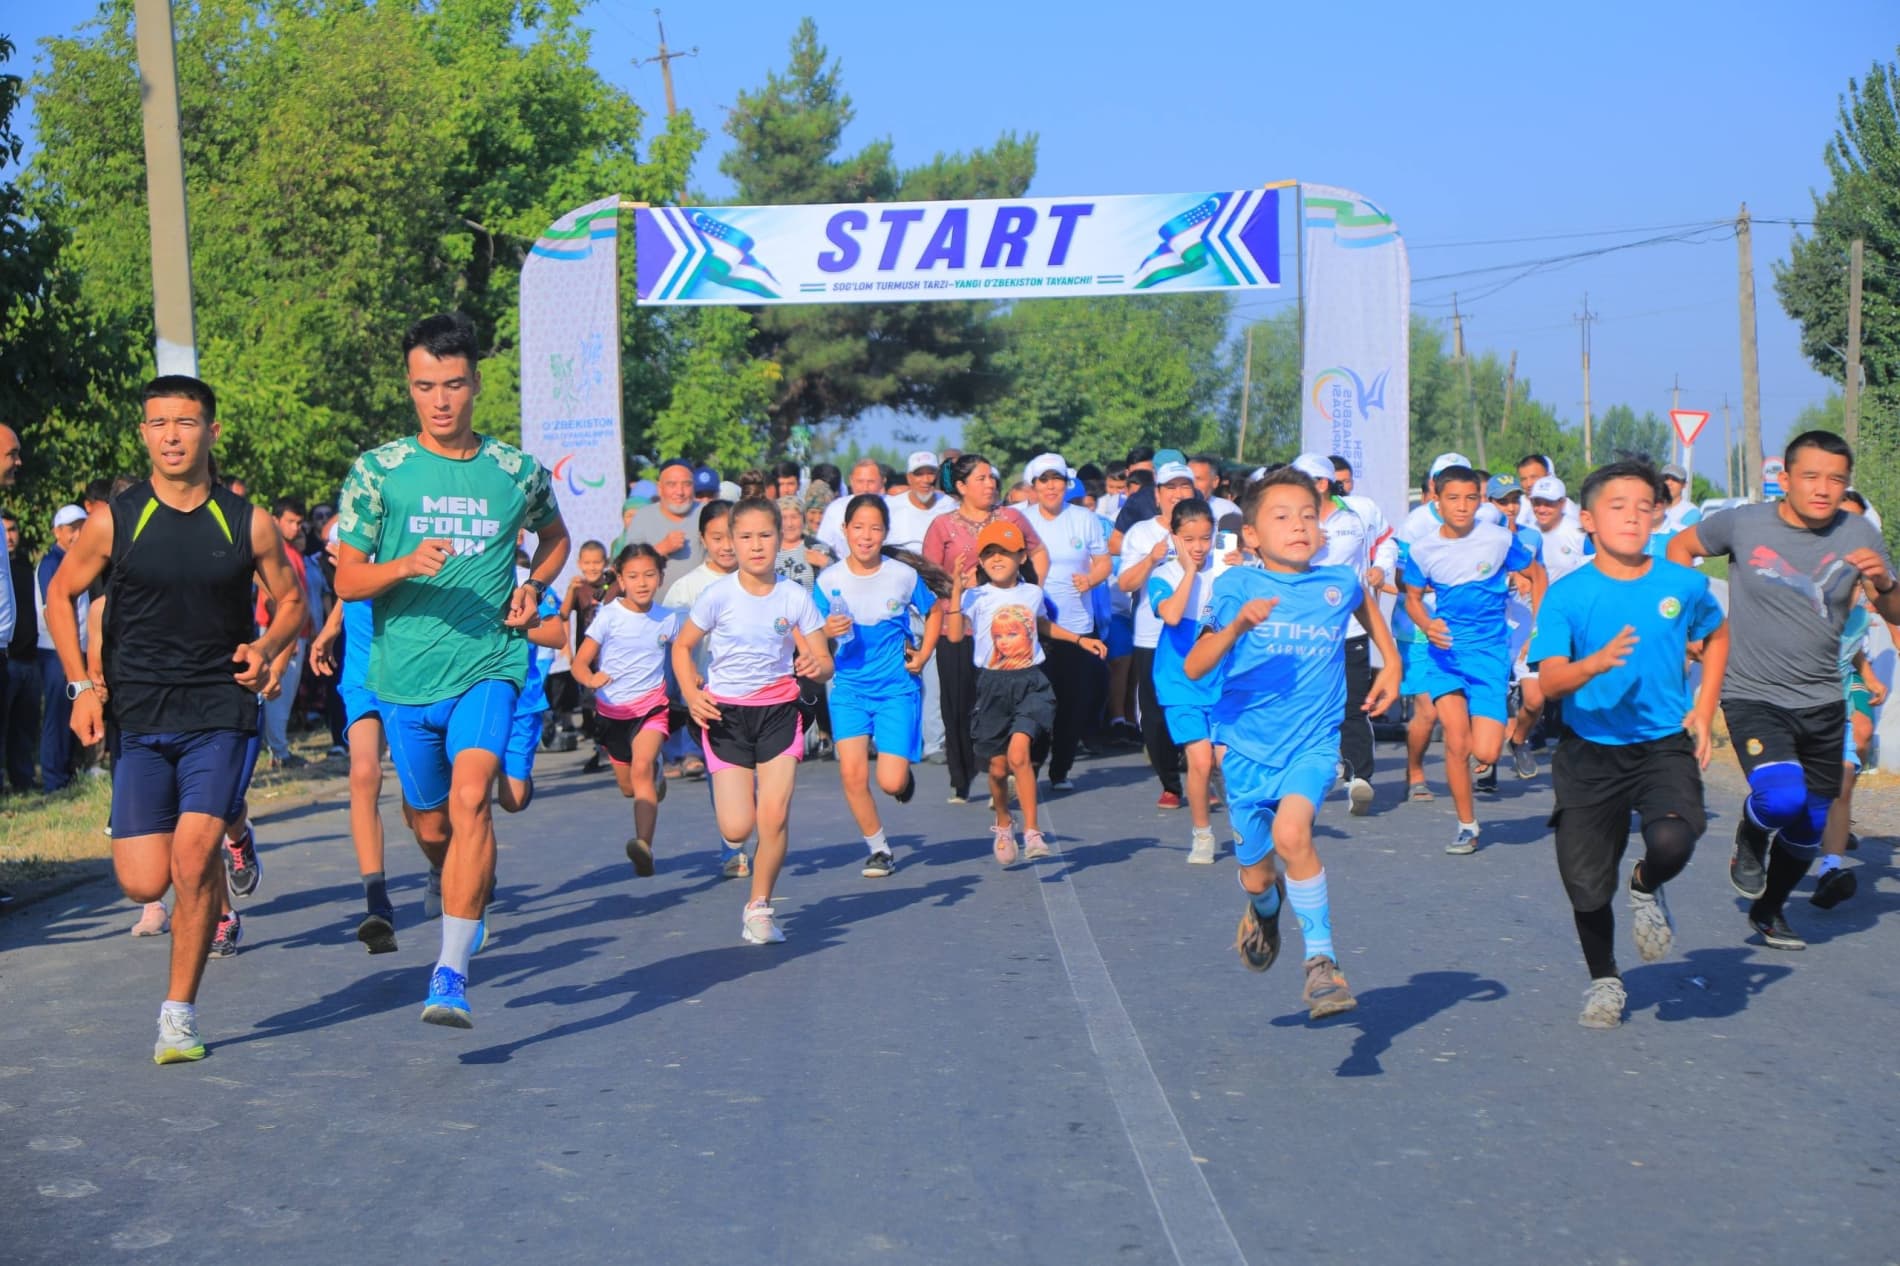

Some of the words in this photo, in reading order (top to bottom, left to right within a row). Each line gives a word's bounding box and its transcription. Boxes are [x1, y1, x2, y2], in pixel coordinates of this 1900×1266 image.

[817, 203, 1095, 273] START
[876, 280, 921, 290] TURMUSH
[984, 278, 1044, 288] O'ZBEKISTON
[422, 495, 488, 516] MEN
[409, 515, 500, 537] G'OLIB
